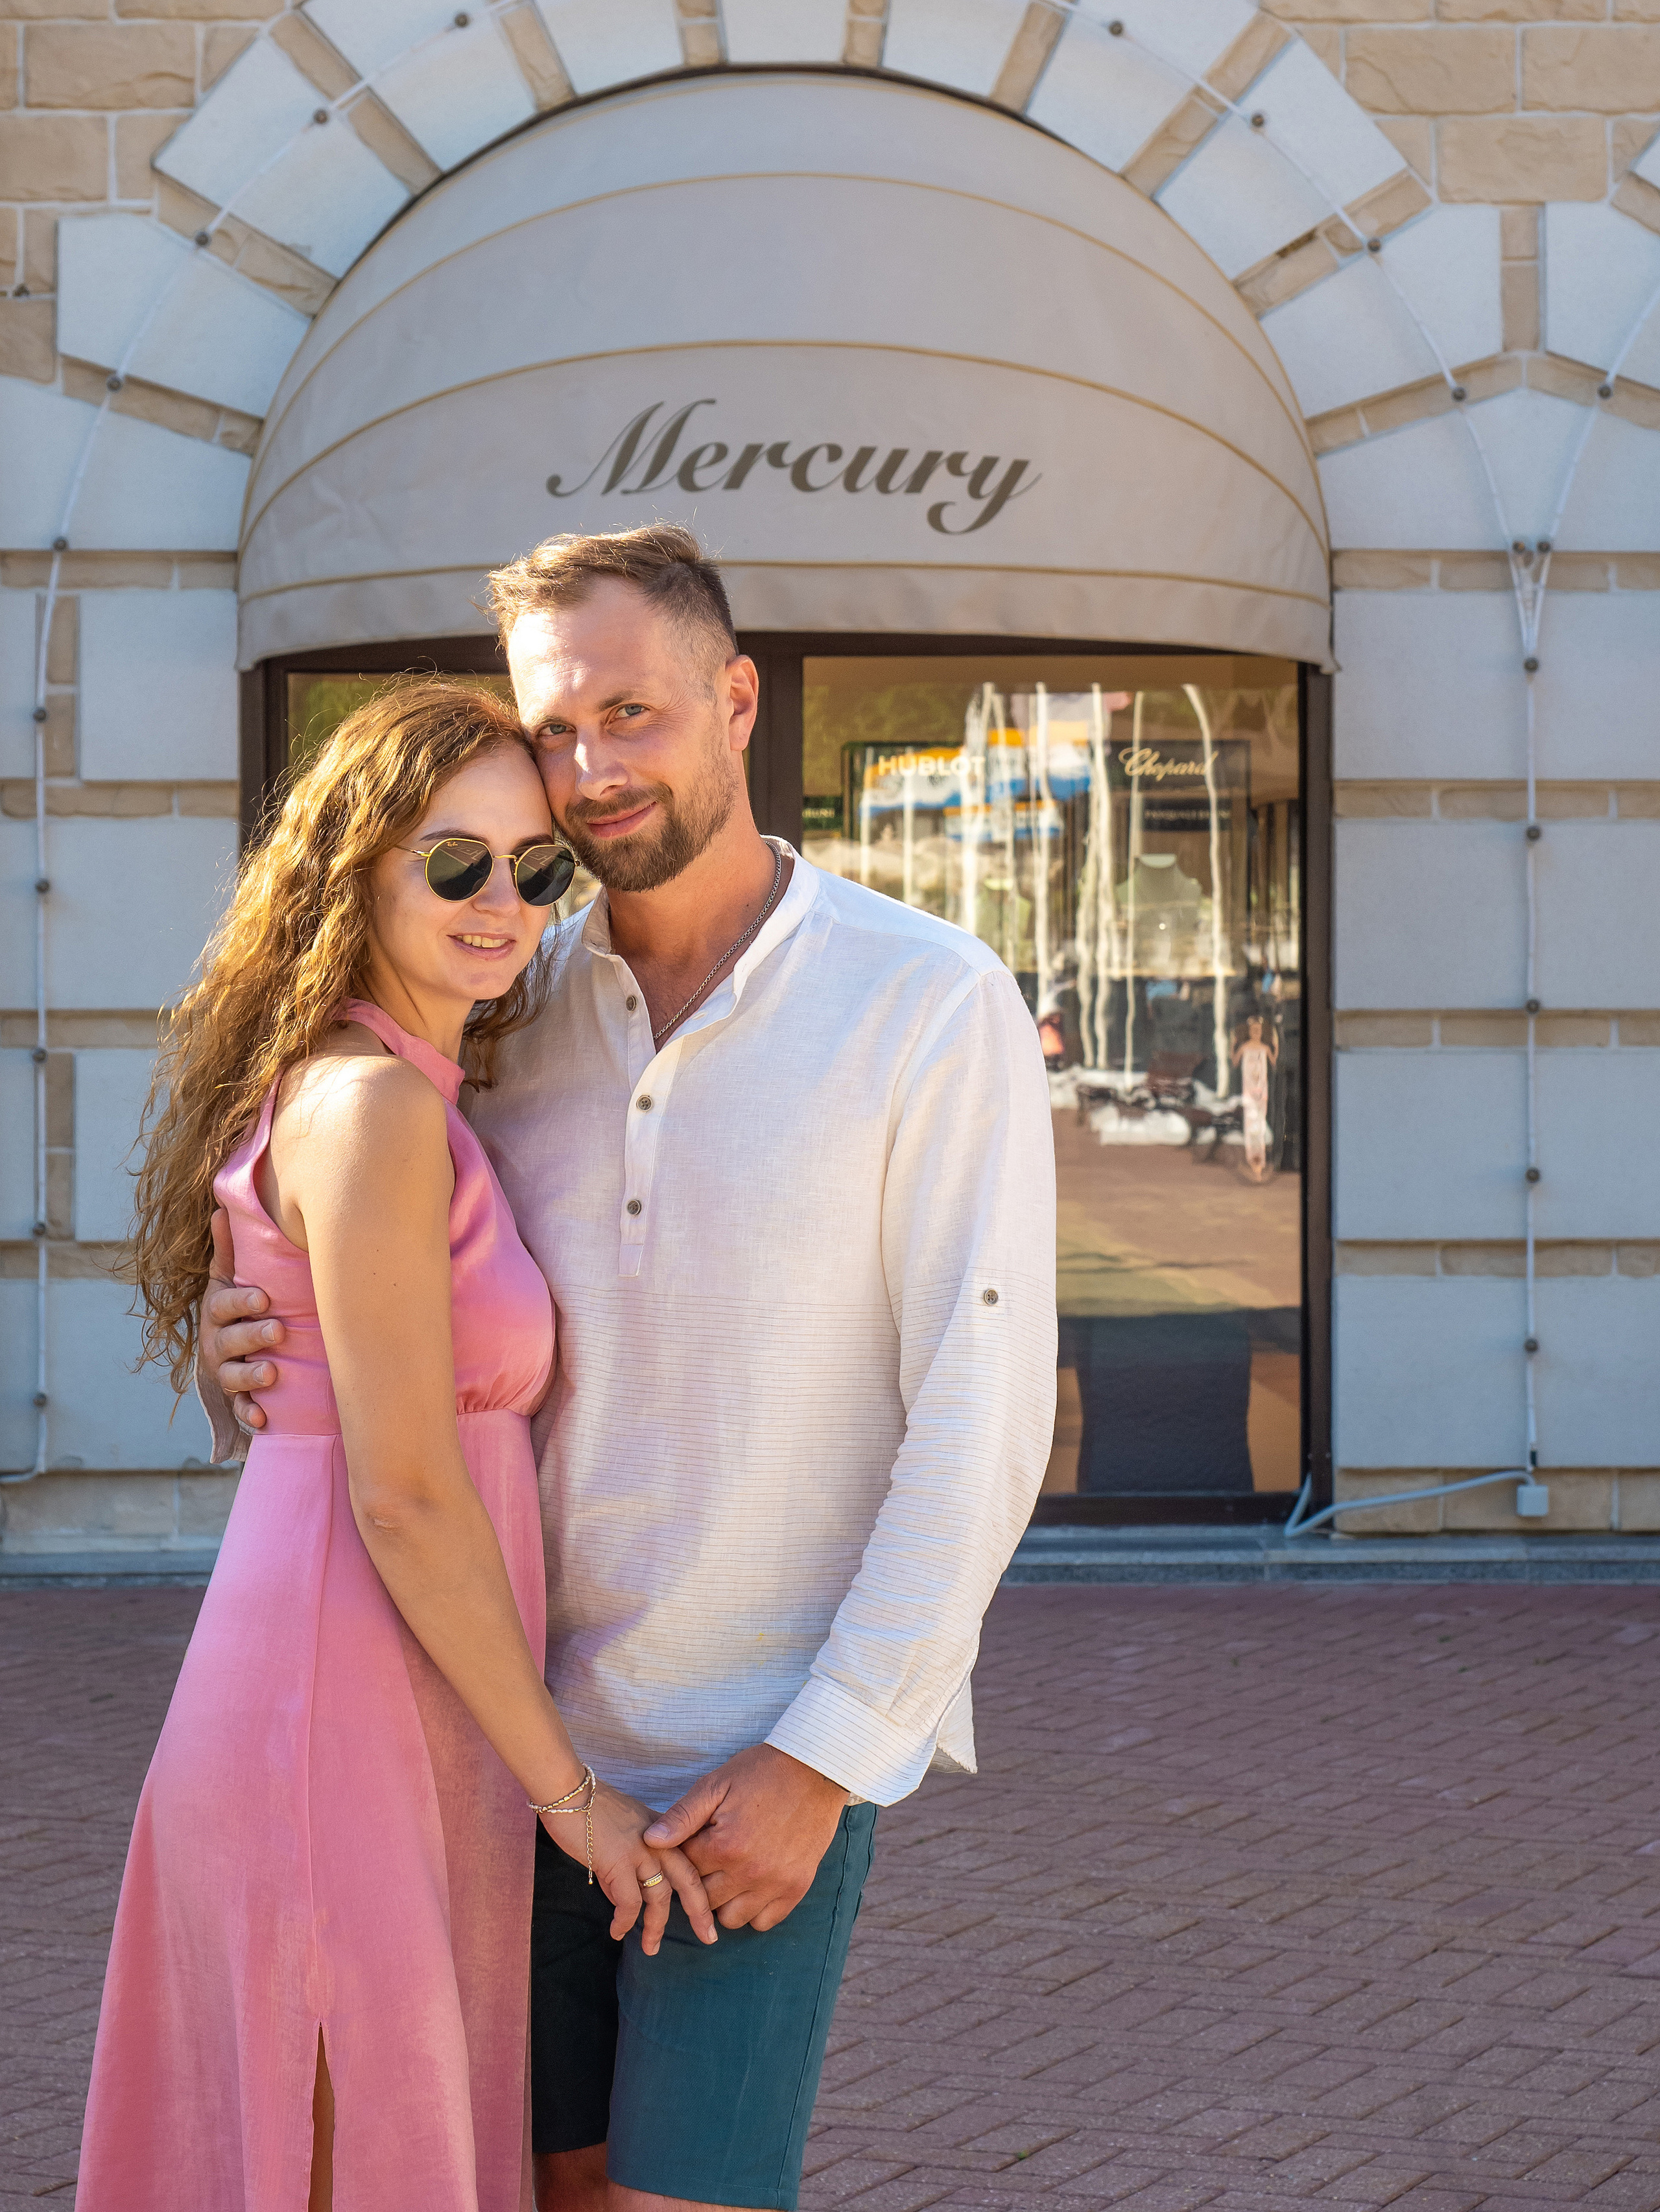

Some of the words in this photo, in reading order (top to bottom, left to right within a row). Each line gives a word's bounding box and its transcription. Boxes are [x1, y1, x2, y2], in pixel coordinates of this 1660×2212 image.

[545, 398, 1042, 535] Mercury
[878, 755, 986, 777] HUBLOT
[1119, 747, 1219, 782] Chopard
